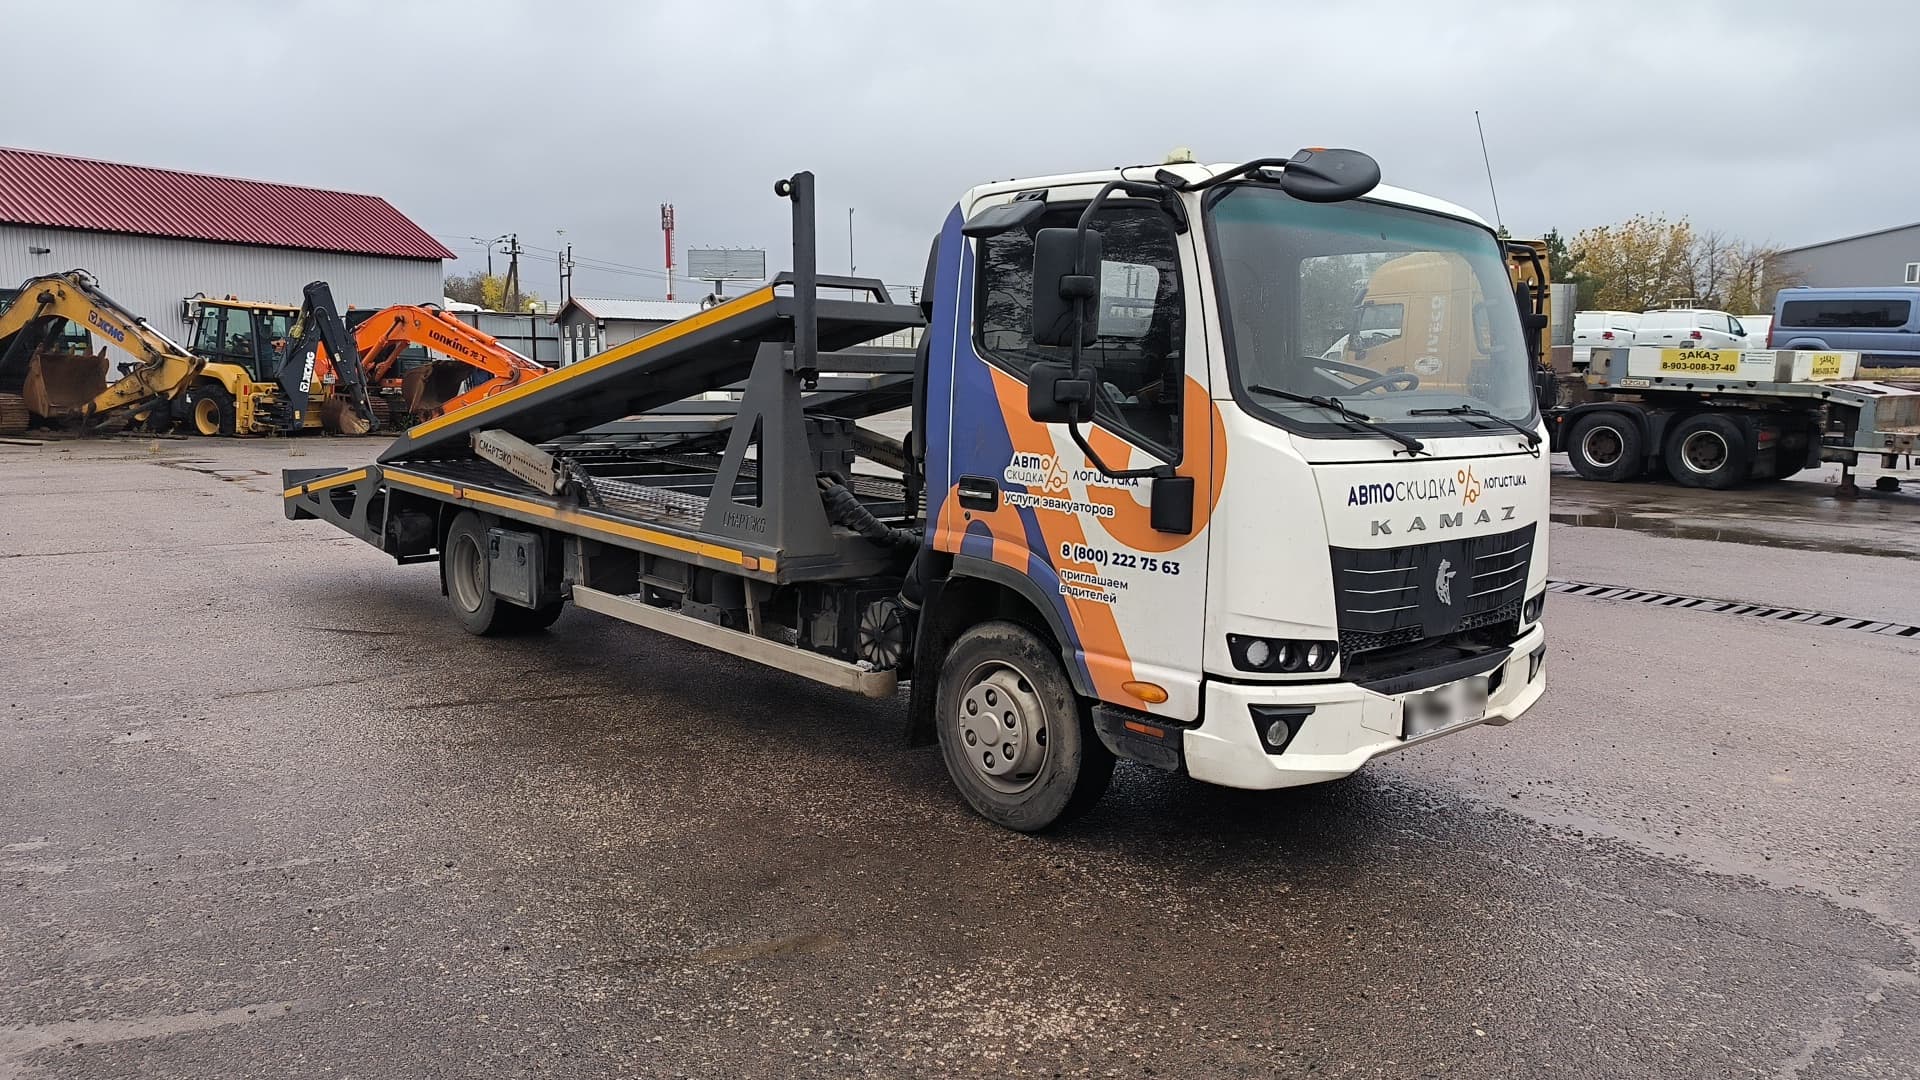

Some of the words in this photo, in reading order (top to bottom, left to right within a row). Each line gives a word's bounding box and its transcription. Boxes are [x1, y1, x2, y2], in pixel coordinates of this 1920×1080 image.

[97, 318, 125, 342] XCMG
[1427, 296, 1441, 352] IVECO
[302, 351, 315, 383] XCMG
[1662, 362, 1735, 372] 8-903-008-37-40
[1679, 350, 1719, 362] ЗАКАЗ
[480, 439, 512, 465] СМАРТЭКО
[1347, 477, 1457, 507] АВТОСКИДКА
[1483, 475, 1527, 490] ЛОГИСТИКА
[1004, 492, 1040, 506] услуги
[1042, 498, 1114, 517] эвакуаторов
[1371, 505, 1516, 537] KAMAZ
[1062, 543, 1070, 557] 8
[1073, 545, 1108, 566] (800)
[1111, 552, 1137, 568] 222
[1140, 557, 1158, 572] 75
[1161, 561, 1181, 575] 63
[1060, 569, 1129, 590] приглашаем
[1060, 584, 1118, 604] водителей
